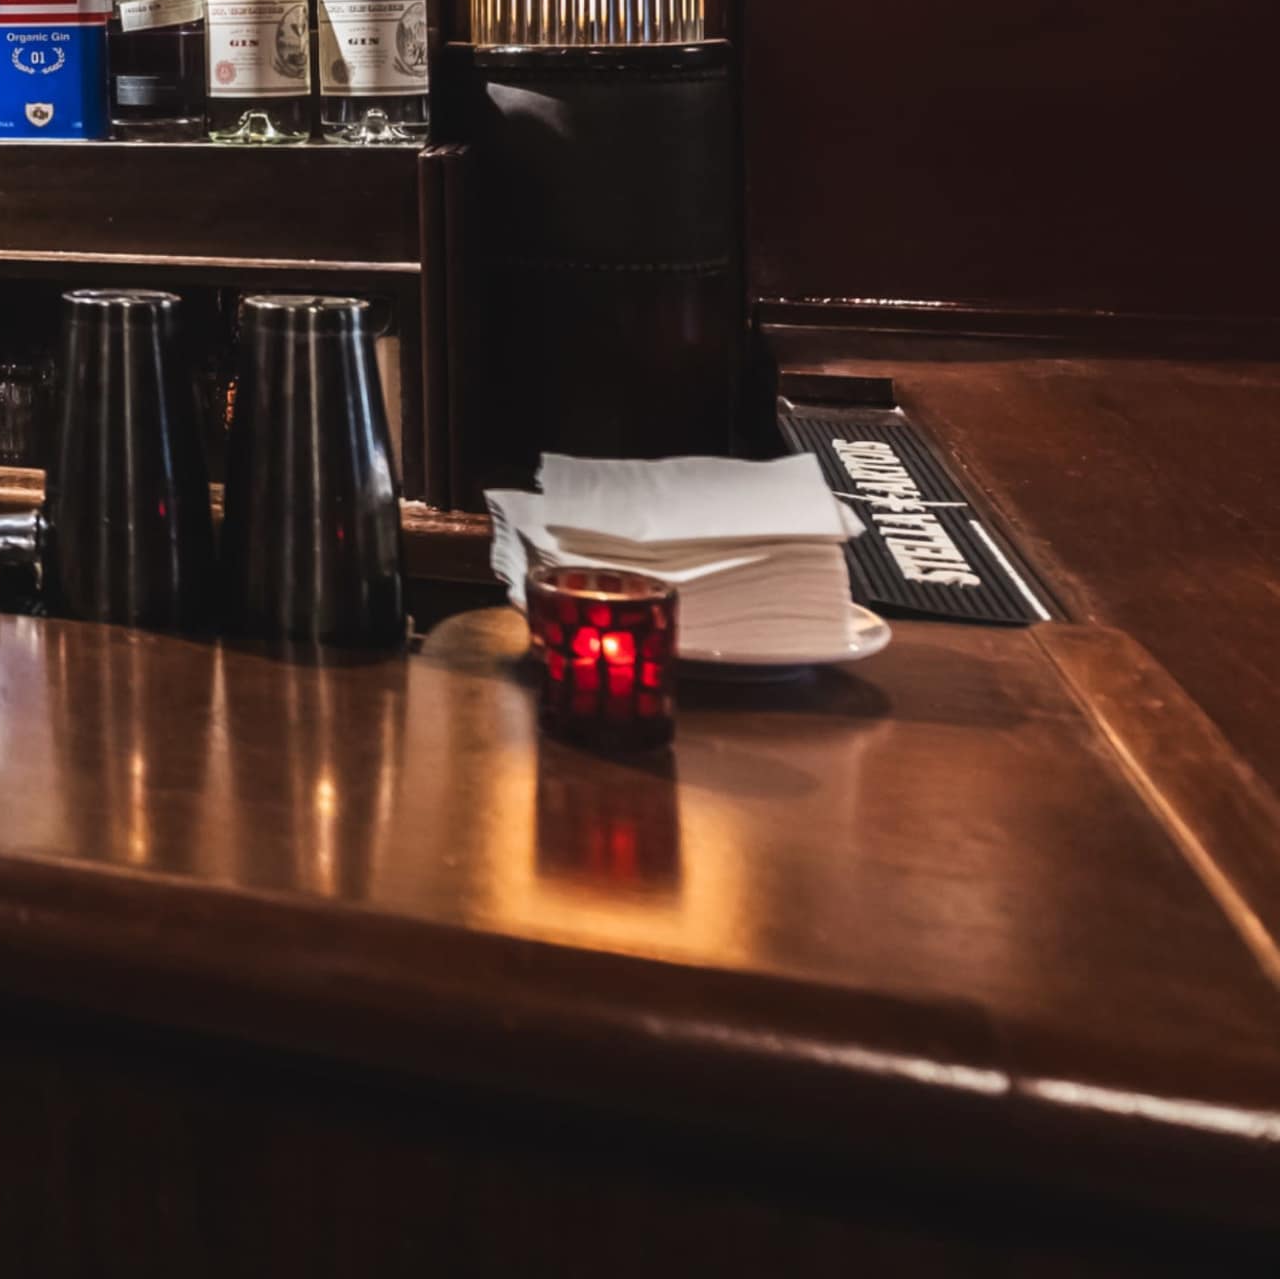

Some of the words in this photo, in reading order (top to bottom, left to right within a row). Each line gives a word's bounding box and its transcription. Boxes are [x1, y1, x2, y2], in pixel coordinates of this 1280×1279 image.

[6, 32, 49, 44] Organic
[51, 31, 70, 42] Gin
[229, 38, 260, 47] GIN
[347, 37, 380, 47] GIN
[30, 50, 46, 65] 01
[870, 513, 982, 588] STELLA
